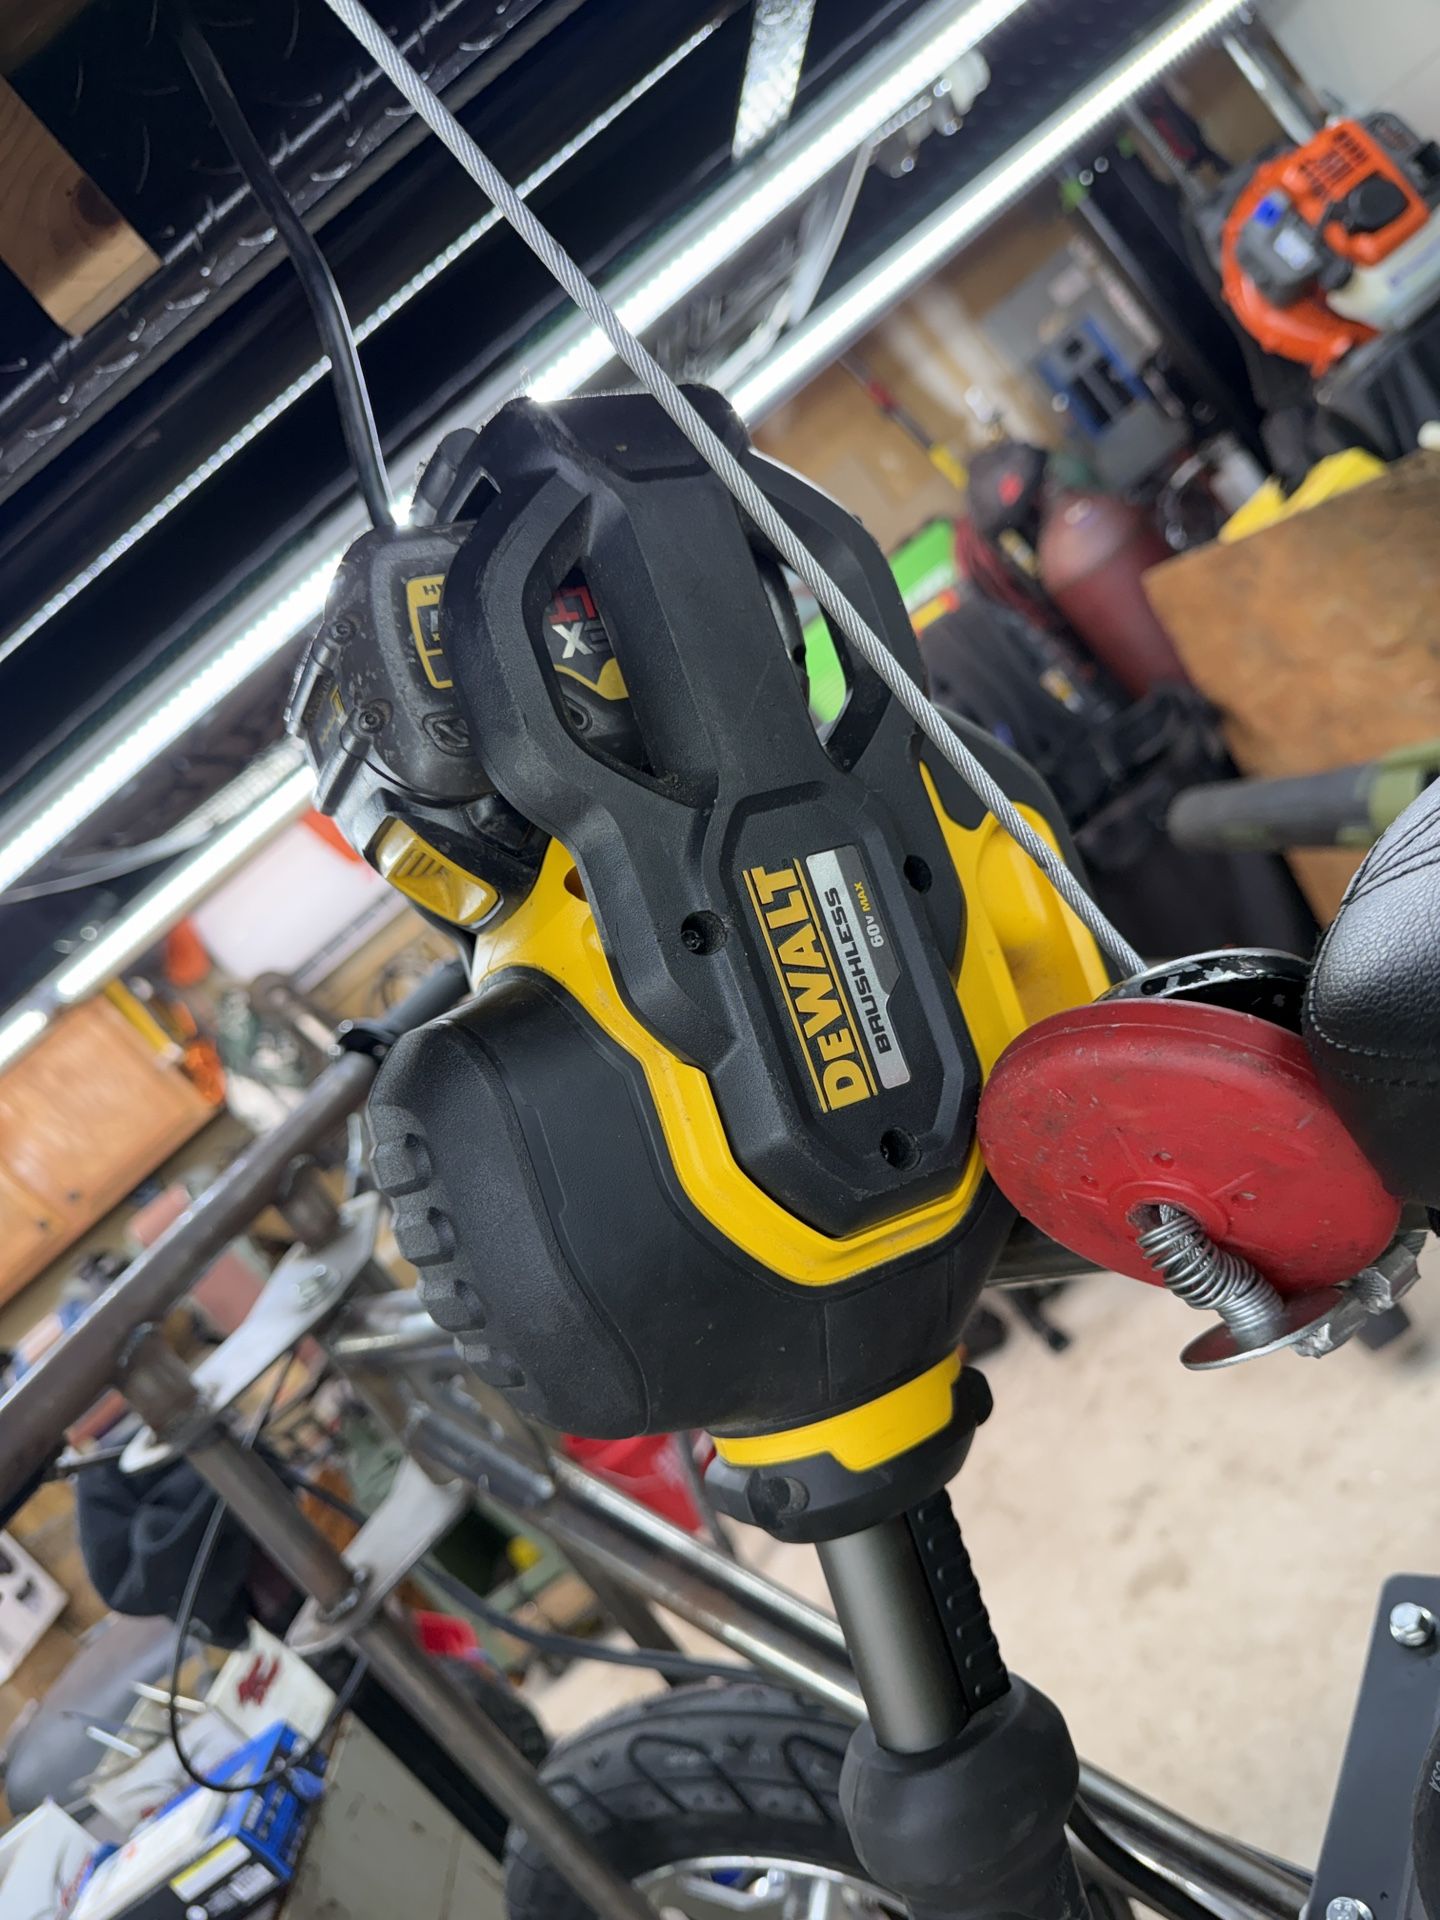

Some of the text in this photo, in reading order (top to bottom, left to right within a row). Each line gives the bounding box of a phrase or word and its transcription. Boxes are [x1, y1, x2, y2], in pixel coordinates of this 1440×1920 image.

[823, 887, 893, 1055] BRUSHLESS
[854, 881, 871, 912] MAX
[750, 865, 872, 1111] DEWALT
